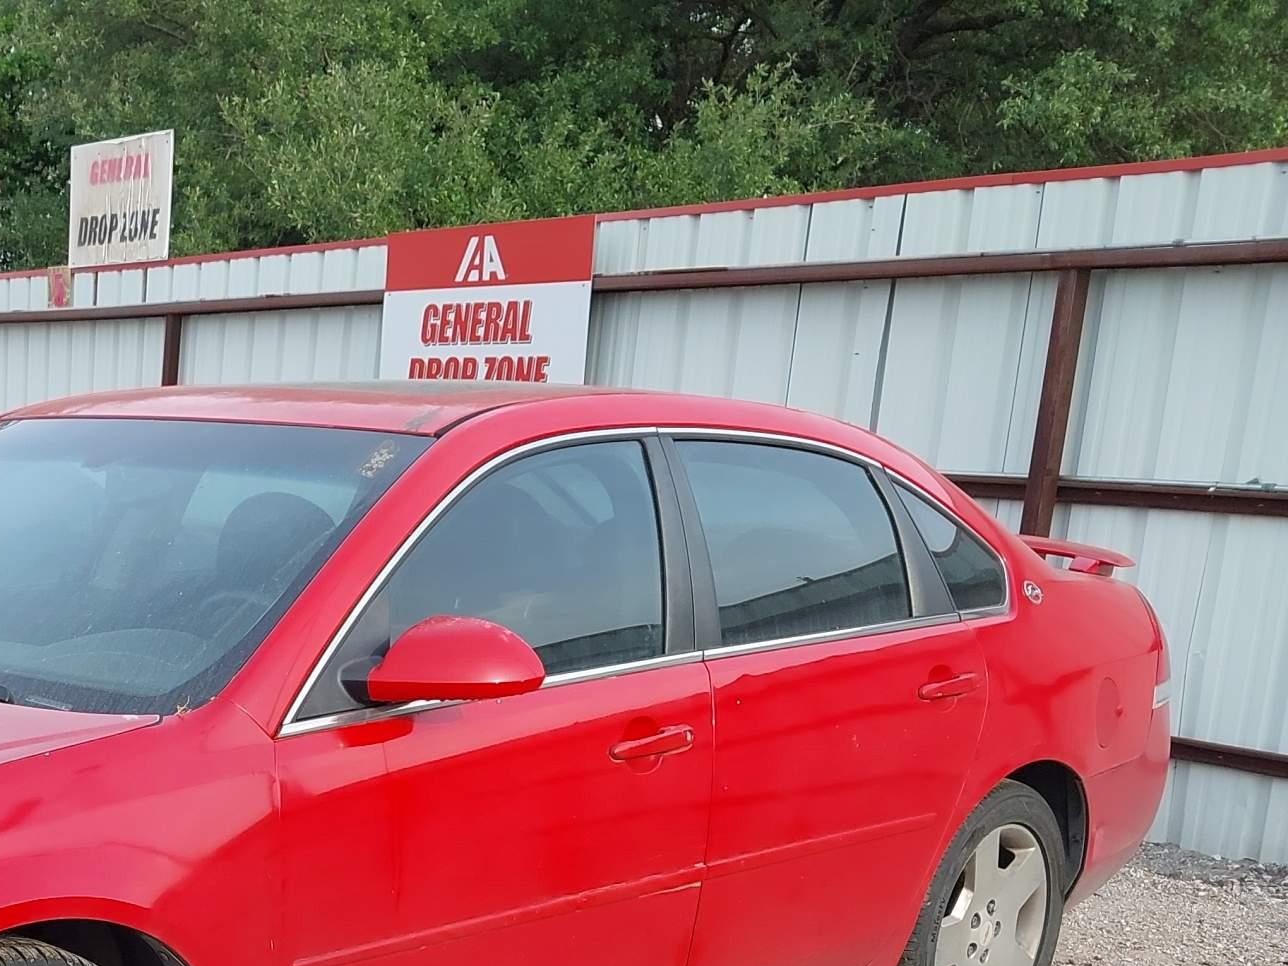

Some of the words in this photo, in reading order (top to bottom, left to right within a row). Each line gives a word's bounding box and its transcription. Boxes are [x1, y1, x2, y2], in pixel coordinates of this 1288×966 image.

[77, 213, 119, 247] DROP
[119, 208, 160, 243] ZONE
[420, 299, 532, 346] GENERAL
